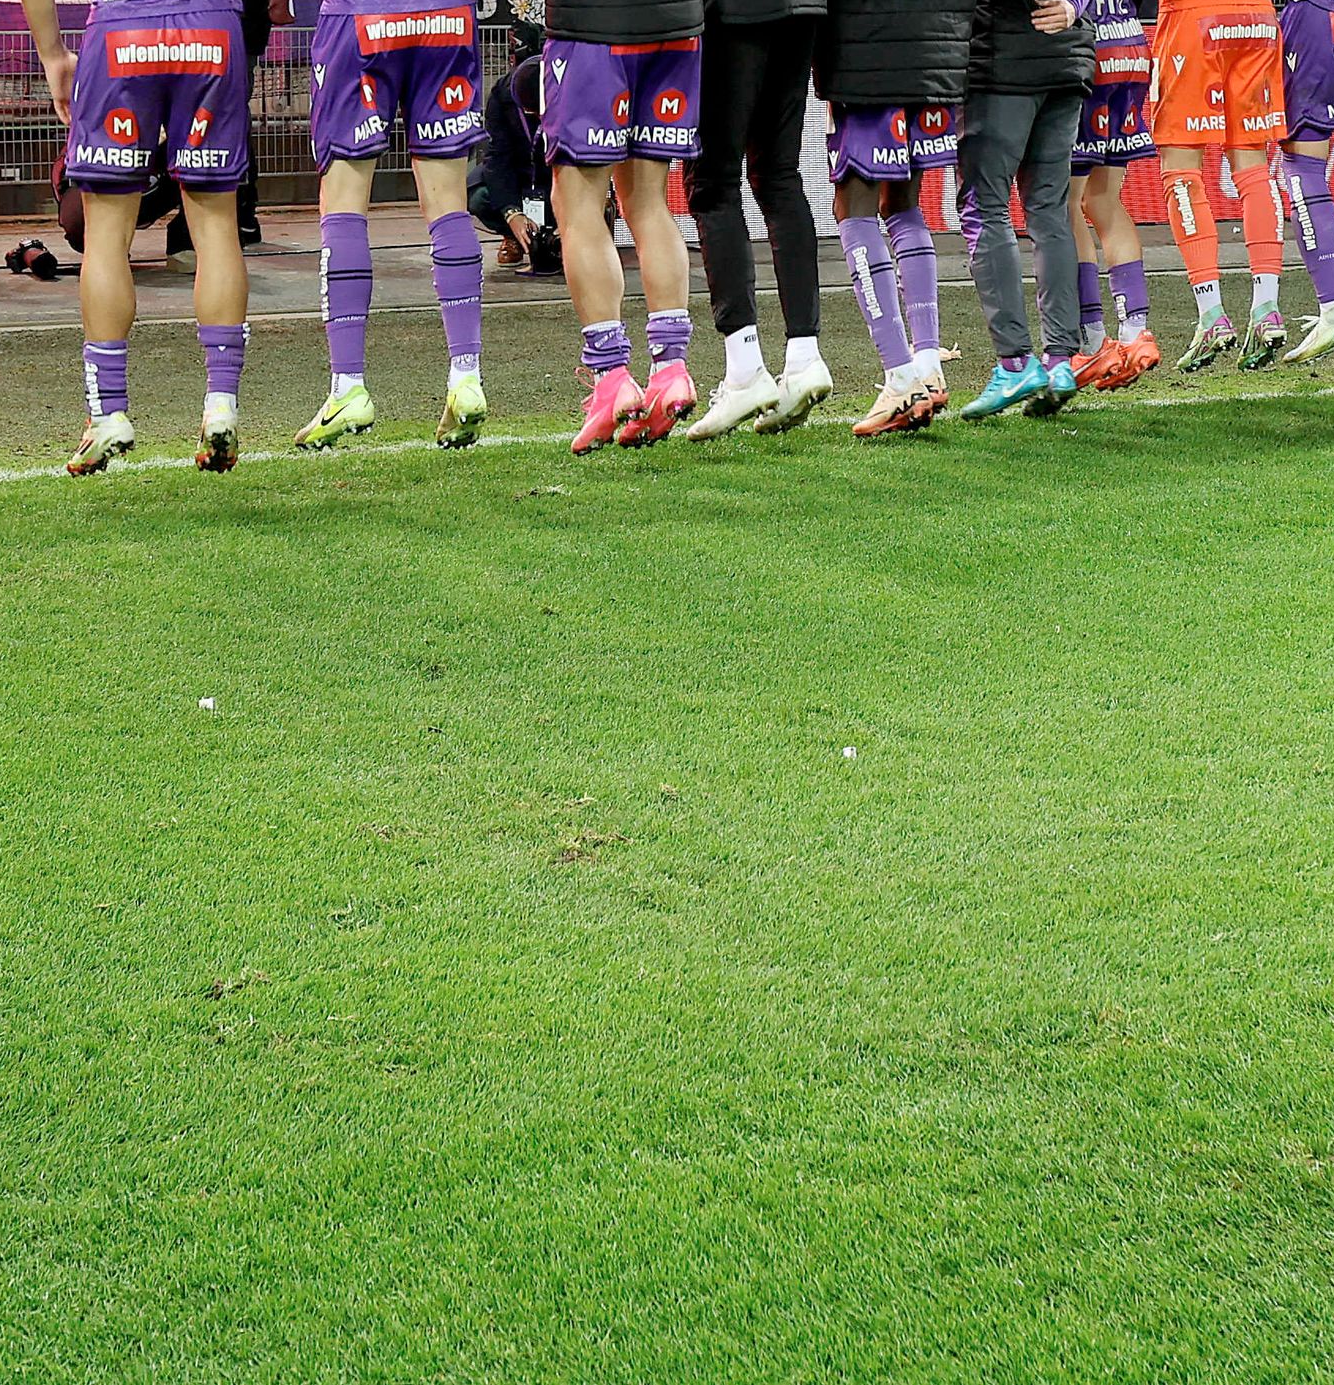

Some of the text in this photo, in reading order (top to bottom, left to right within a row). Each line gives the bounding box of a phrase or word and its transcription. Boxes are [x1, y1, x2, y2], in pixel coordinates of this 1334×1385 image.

[364, 15, 465, 41] wienholding
[115, 42, 223, 65] wienholding
[445, 84, 464, 105] M
[660, 97, 680, 115] M
[113, 117, 132, 136] M
[190, 118, 208, 137] M
[925, 111, 942, 128] M
[1290, 175, 1317, 251] wienholding
